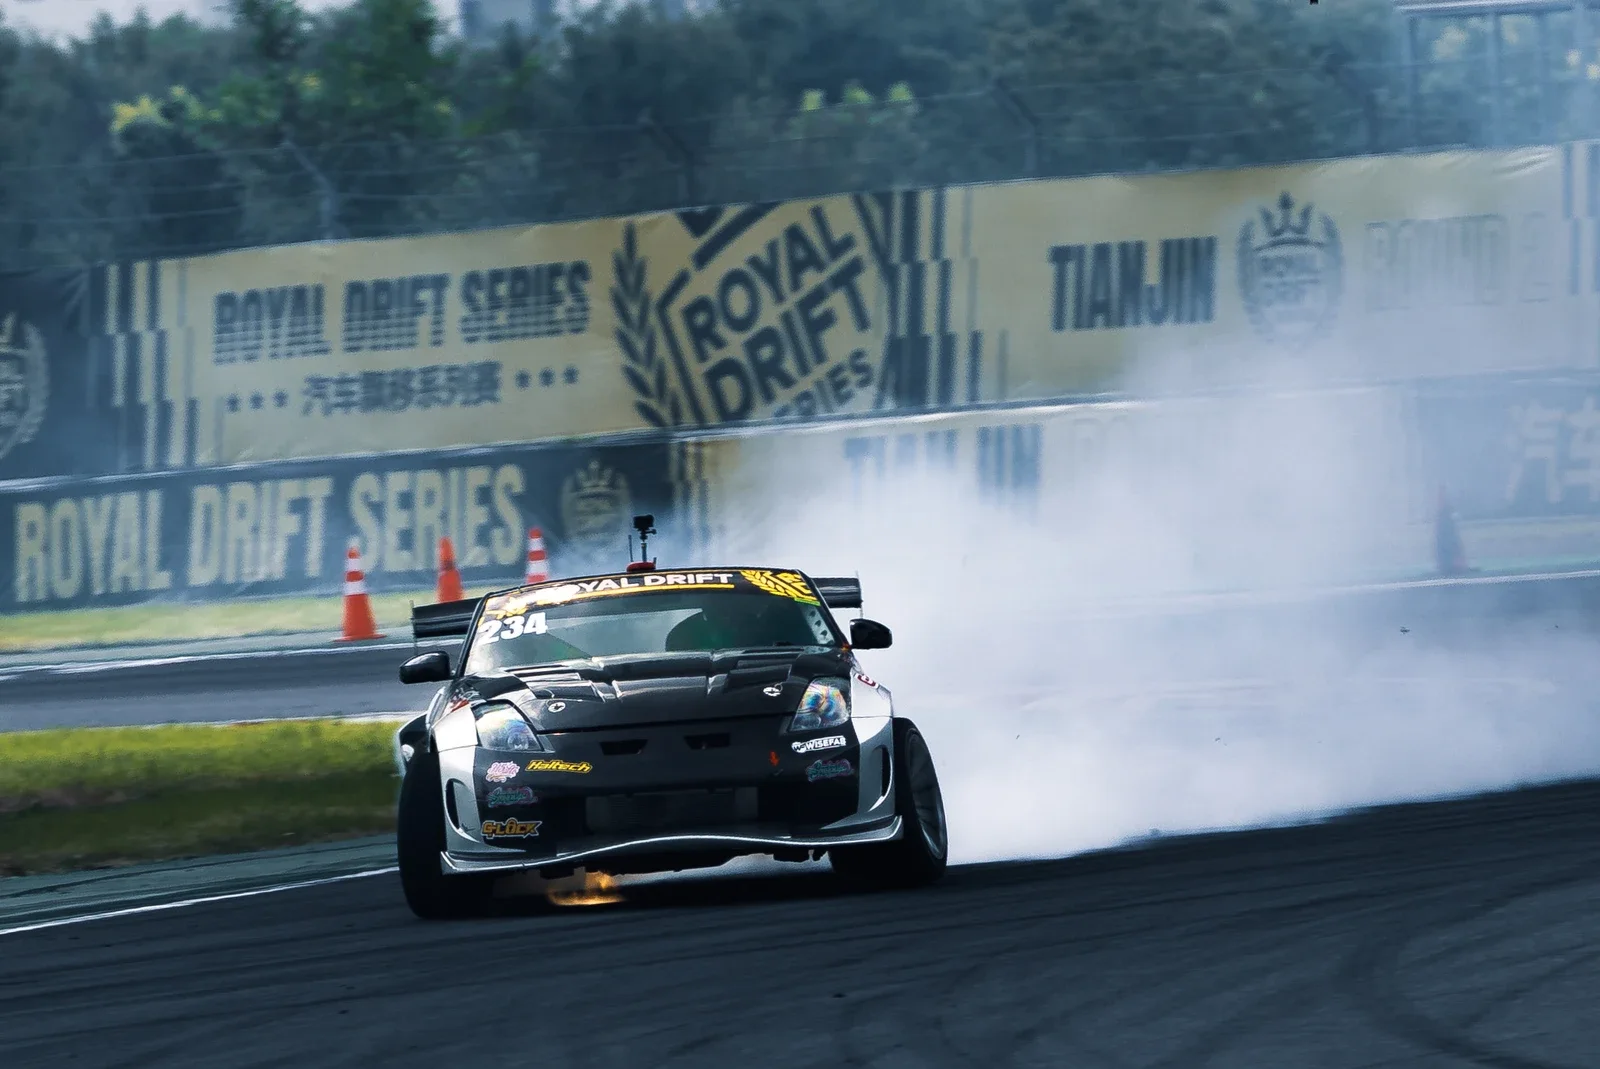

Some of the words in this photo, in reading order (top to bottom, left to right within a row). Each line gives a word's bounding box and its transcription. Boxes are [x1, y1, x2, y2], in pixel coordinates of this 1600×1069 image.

[213, 284, 331, 364] ROYAL
[343, 273, 451, 352] DRIFT
[458, 260, 592, 343] SERIES
[679, 205, 858, 362] ROYAL
[1048, 237, 1217, 331] TIANJIN
[703, 256, 871, 424] DRIFT
[15, 491, 171, 602] ROYAL
[187, 475, 334, 587] DRIFT
[349, 465, 525, 574] SERIES
[645, 573, 734, 586] DRIFT
[478, 611, 548, 644] 234
[527, 760, 591, 772] Haltech
